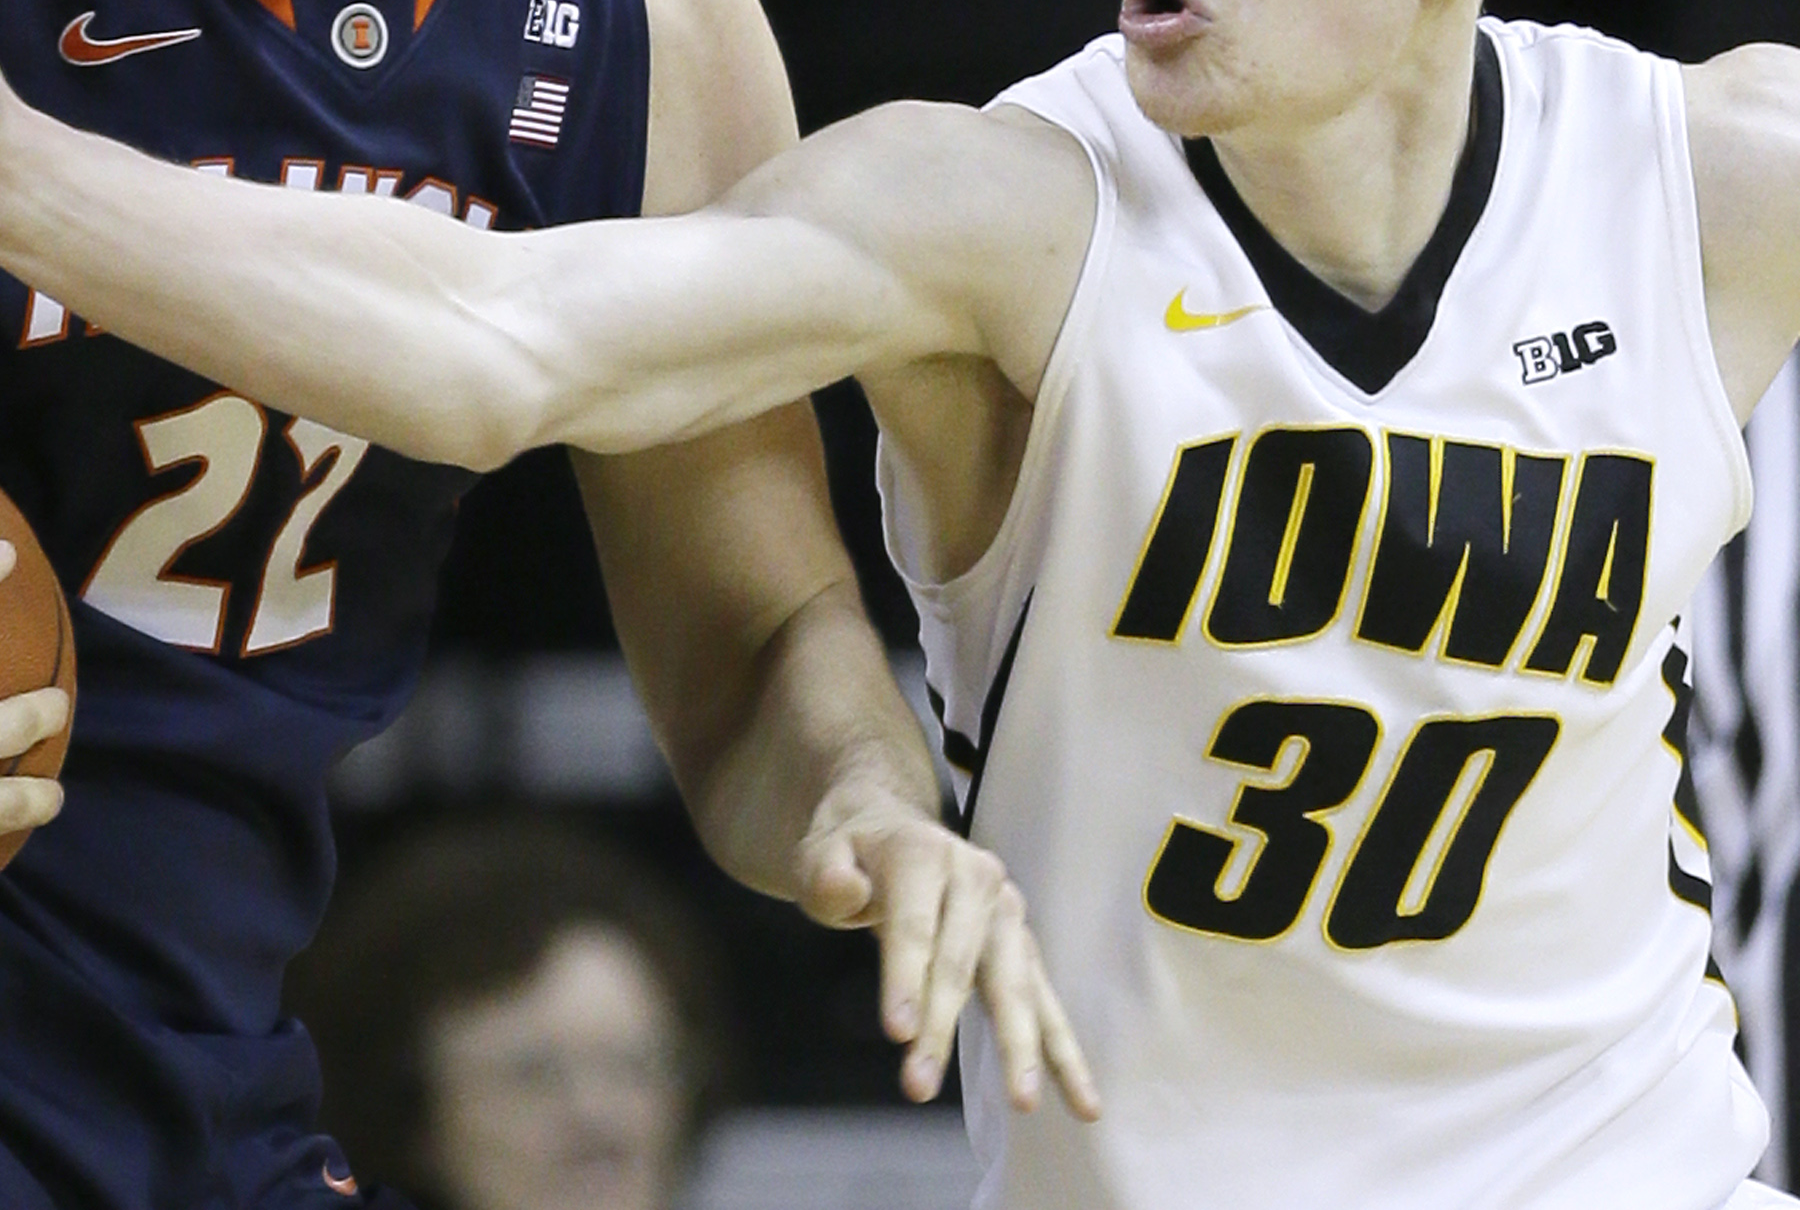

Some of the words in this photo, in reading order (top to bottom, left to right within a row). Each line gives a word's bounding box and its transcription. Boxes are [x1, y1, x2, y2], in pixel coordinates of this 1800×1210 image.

[80, 390, 371, 658] 22
[1107, 422, 1657, 688] IOWA
[1142, 698, 1563, 952] 30
